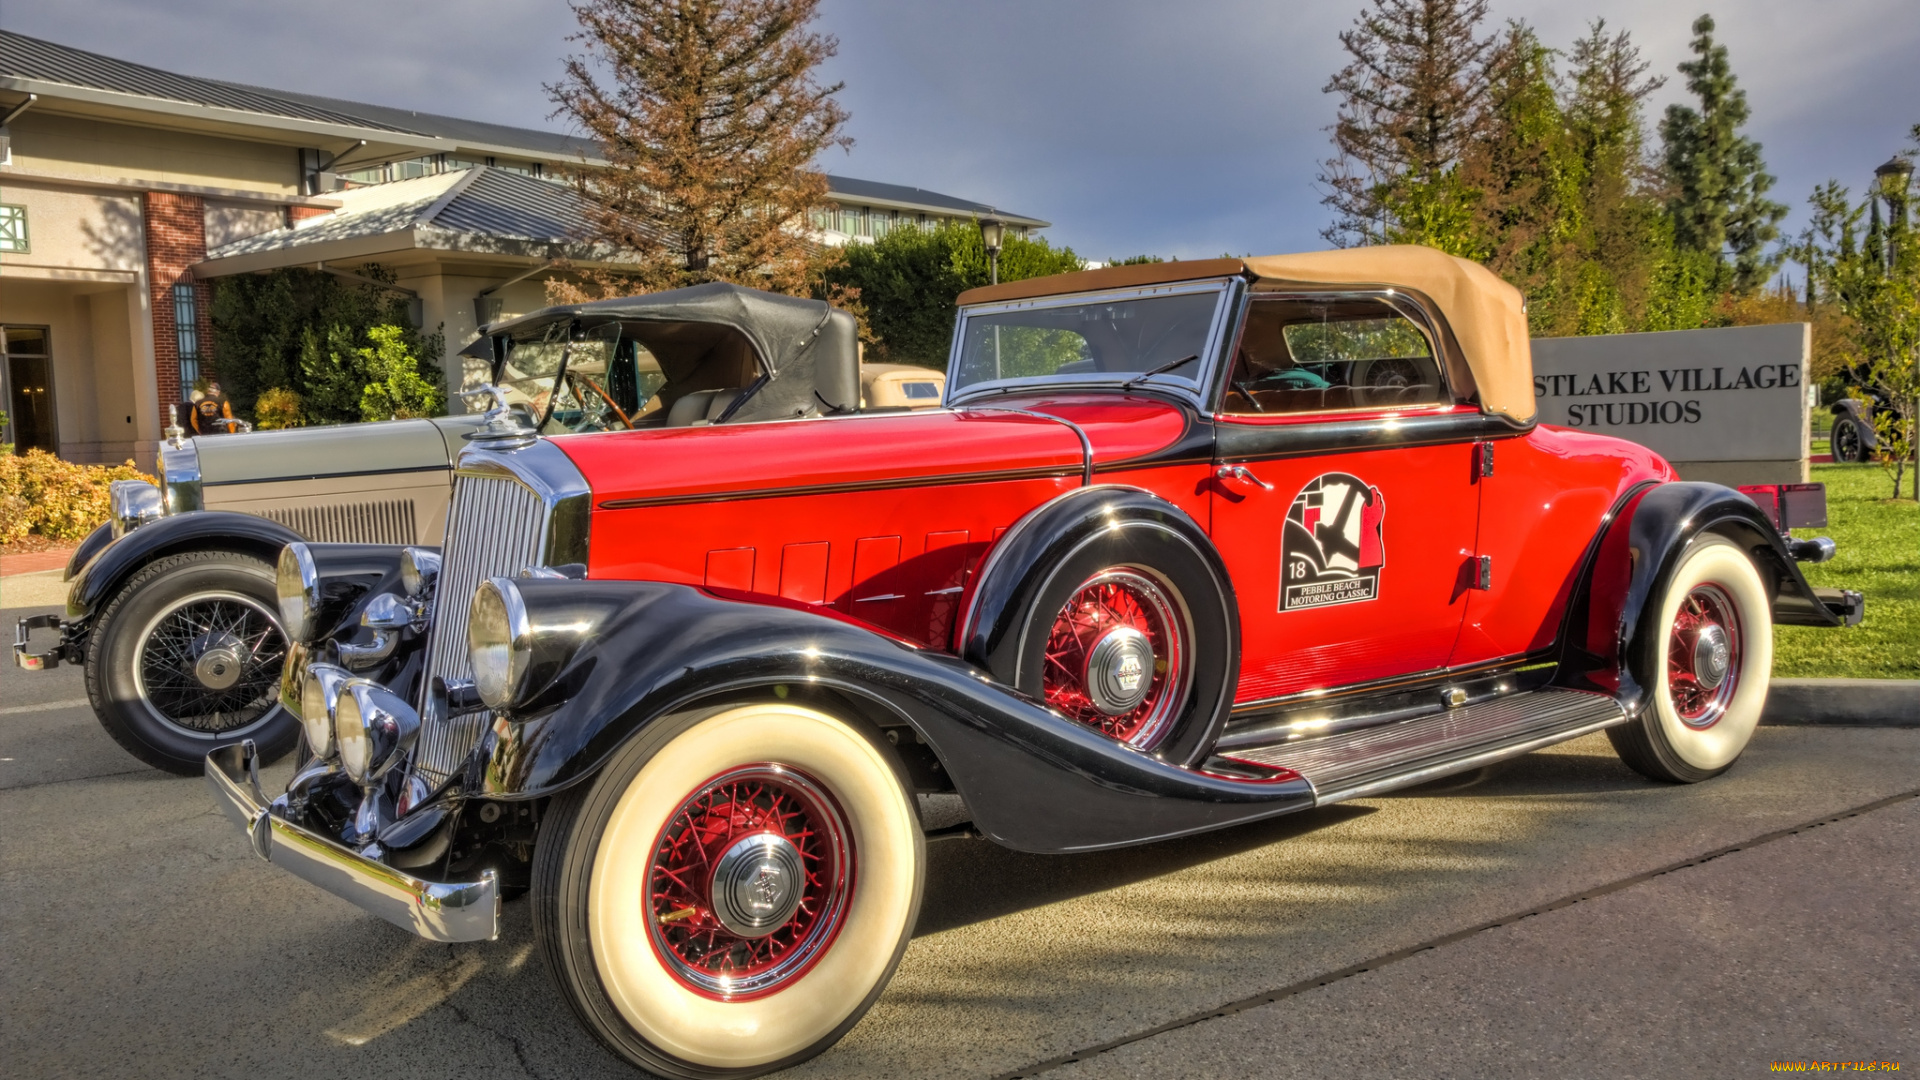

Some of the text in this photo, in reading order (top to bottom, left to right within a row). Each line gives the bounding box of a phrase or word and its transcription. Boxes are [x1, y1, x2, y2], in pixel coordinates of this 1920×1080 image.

[1658, 363, 1800, 392] VILLAGE
[1567, 400, 1702, 427] STUDIOS
[1289, 561, 1306, 579] 18
[1290, 588, 1370, 606] MOTORING CLASSIC
[1301, 580, 1361, 596] PEBBLE BEACH
